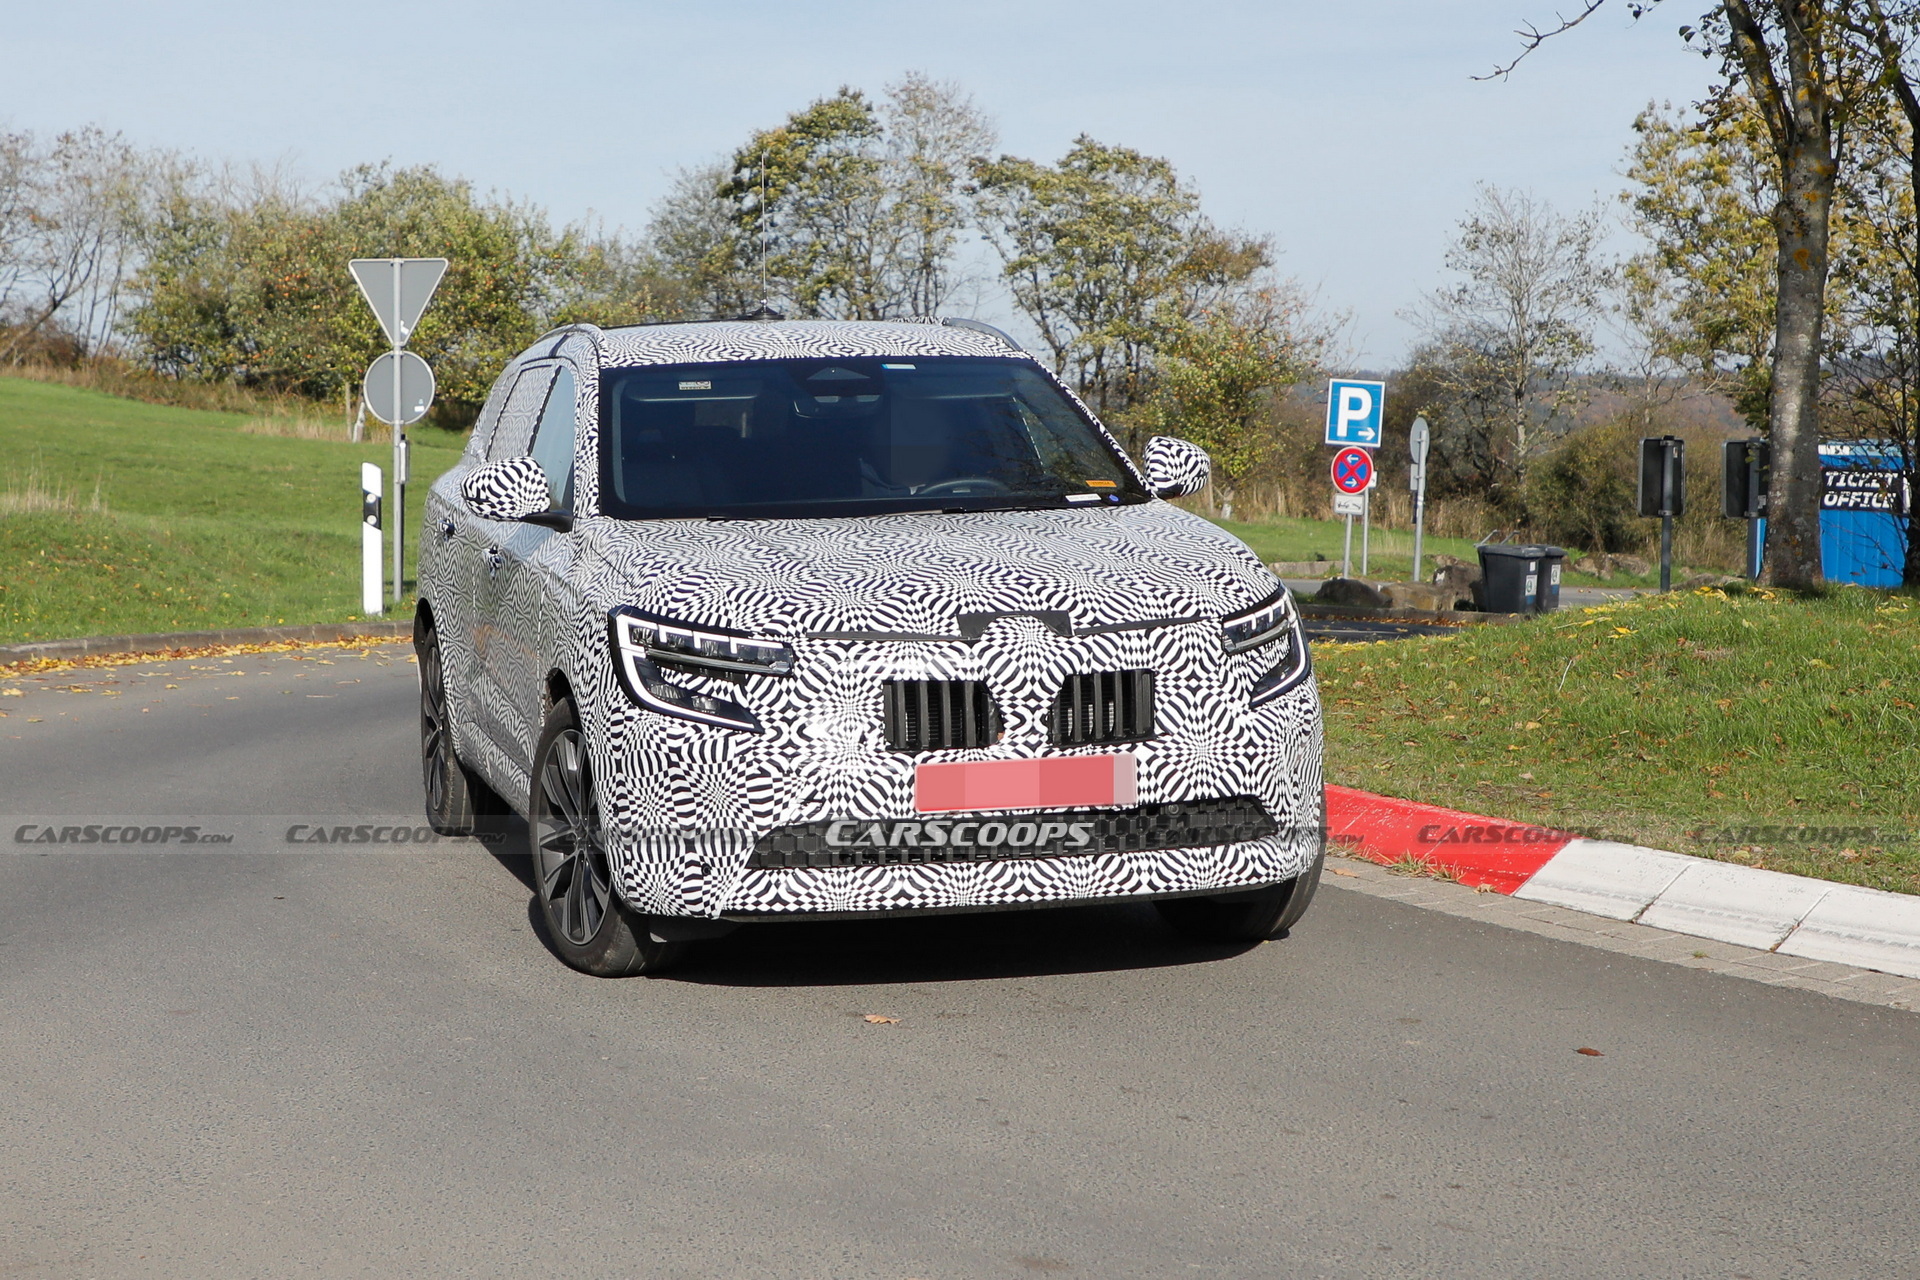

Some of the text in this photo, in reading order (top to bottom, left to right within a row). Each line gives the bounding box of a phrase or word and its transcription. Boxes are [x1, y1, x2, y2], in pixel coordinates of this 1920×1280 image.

[1336, 386, 1372, 437] P
[1825, 471, 1899, 488] TICKET
[1823, 491, 1897, 509] OFFICE
